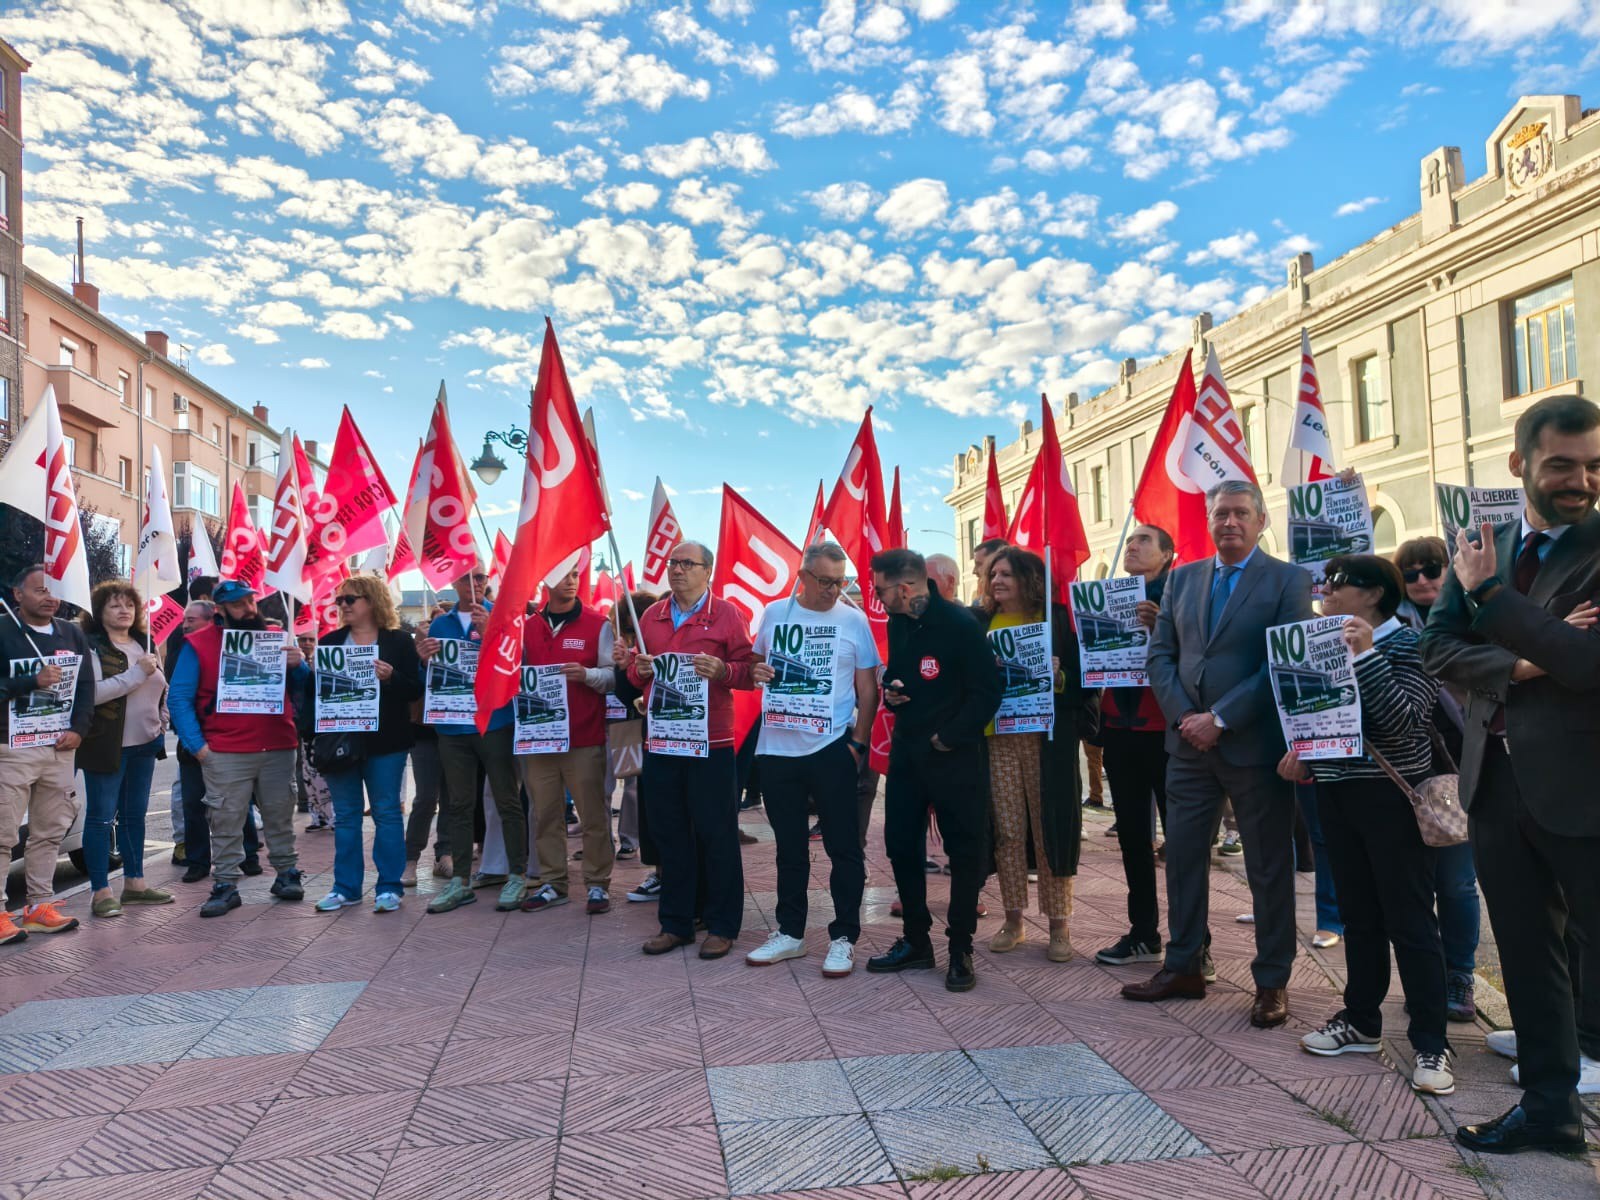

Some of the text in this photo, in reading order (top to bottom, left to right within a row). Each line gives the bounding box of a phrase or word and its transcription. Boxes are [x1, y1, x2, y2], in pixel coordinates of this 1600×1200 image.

[1194, 441, 1227, 479] León
[1324, 482, 1333, 492] AL
[1288, 483, 1323, 519] NO
[1326, 495, 1360, 509] CENTRO DE
[1470, 489, 1519, 503] AL CIERRE
[1437, 486, 1470, 528] NO
[1337, 510, 1363, 524] ADIF
[1473, 512, 1514, 523] CENTRO DE
[138, 529, 160, 555] eón
[644, 507, 680, 577] CCO
[1104, 577, 1139, 591] AL CIERRE
[1072, 581, 1105, 613] NO
[1107, 596, 1128, 606] CENTRO
[804, 626, 837, 635] AL CIERRE
[1014, 624, 1044, 638] AL CIERRE
[1305, 625, 1316, 635] AL
[225, 631, 254, 655] NO
[772, 624, 804, 655] NO
[1269, 624, 1305, 665] NO
[1308, 637, 1342, 653] CENTRO DE
[354, 646, 374, 654] CIERRE
[804, 643, 823, 651] CENTRO
[48, 656, 80, 666] AL CIERRE
[261, 655, 281, 663] ADIF
[317, 647, 345, 671] NO
[810, 657, 831, 667] ADIF
[1027, 654, 1044, 667] ADIF
[1324, 655, 1347, 672] ADIF
[355, 670, 373, 678] ADIF
[653, 653, 679, 682] NO
[58, 682, 73, 690] ADIF
[683, 683, 701, 693] ADIF
[546, 690, 561, 699] ADIF
[1315, 740, 1329, 749] UGT
[1340, 738, 1357, 748] CGT
